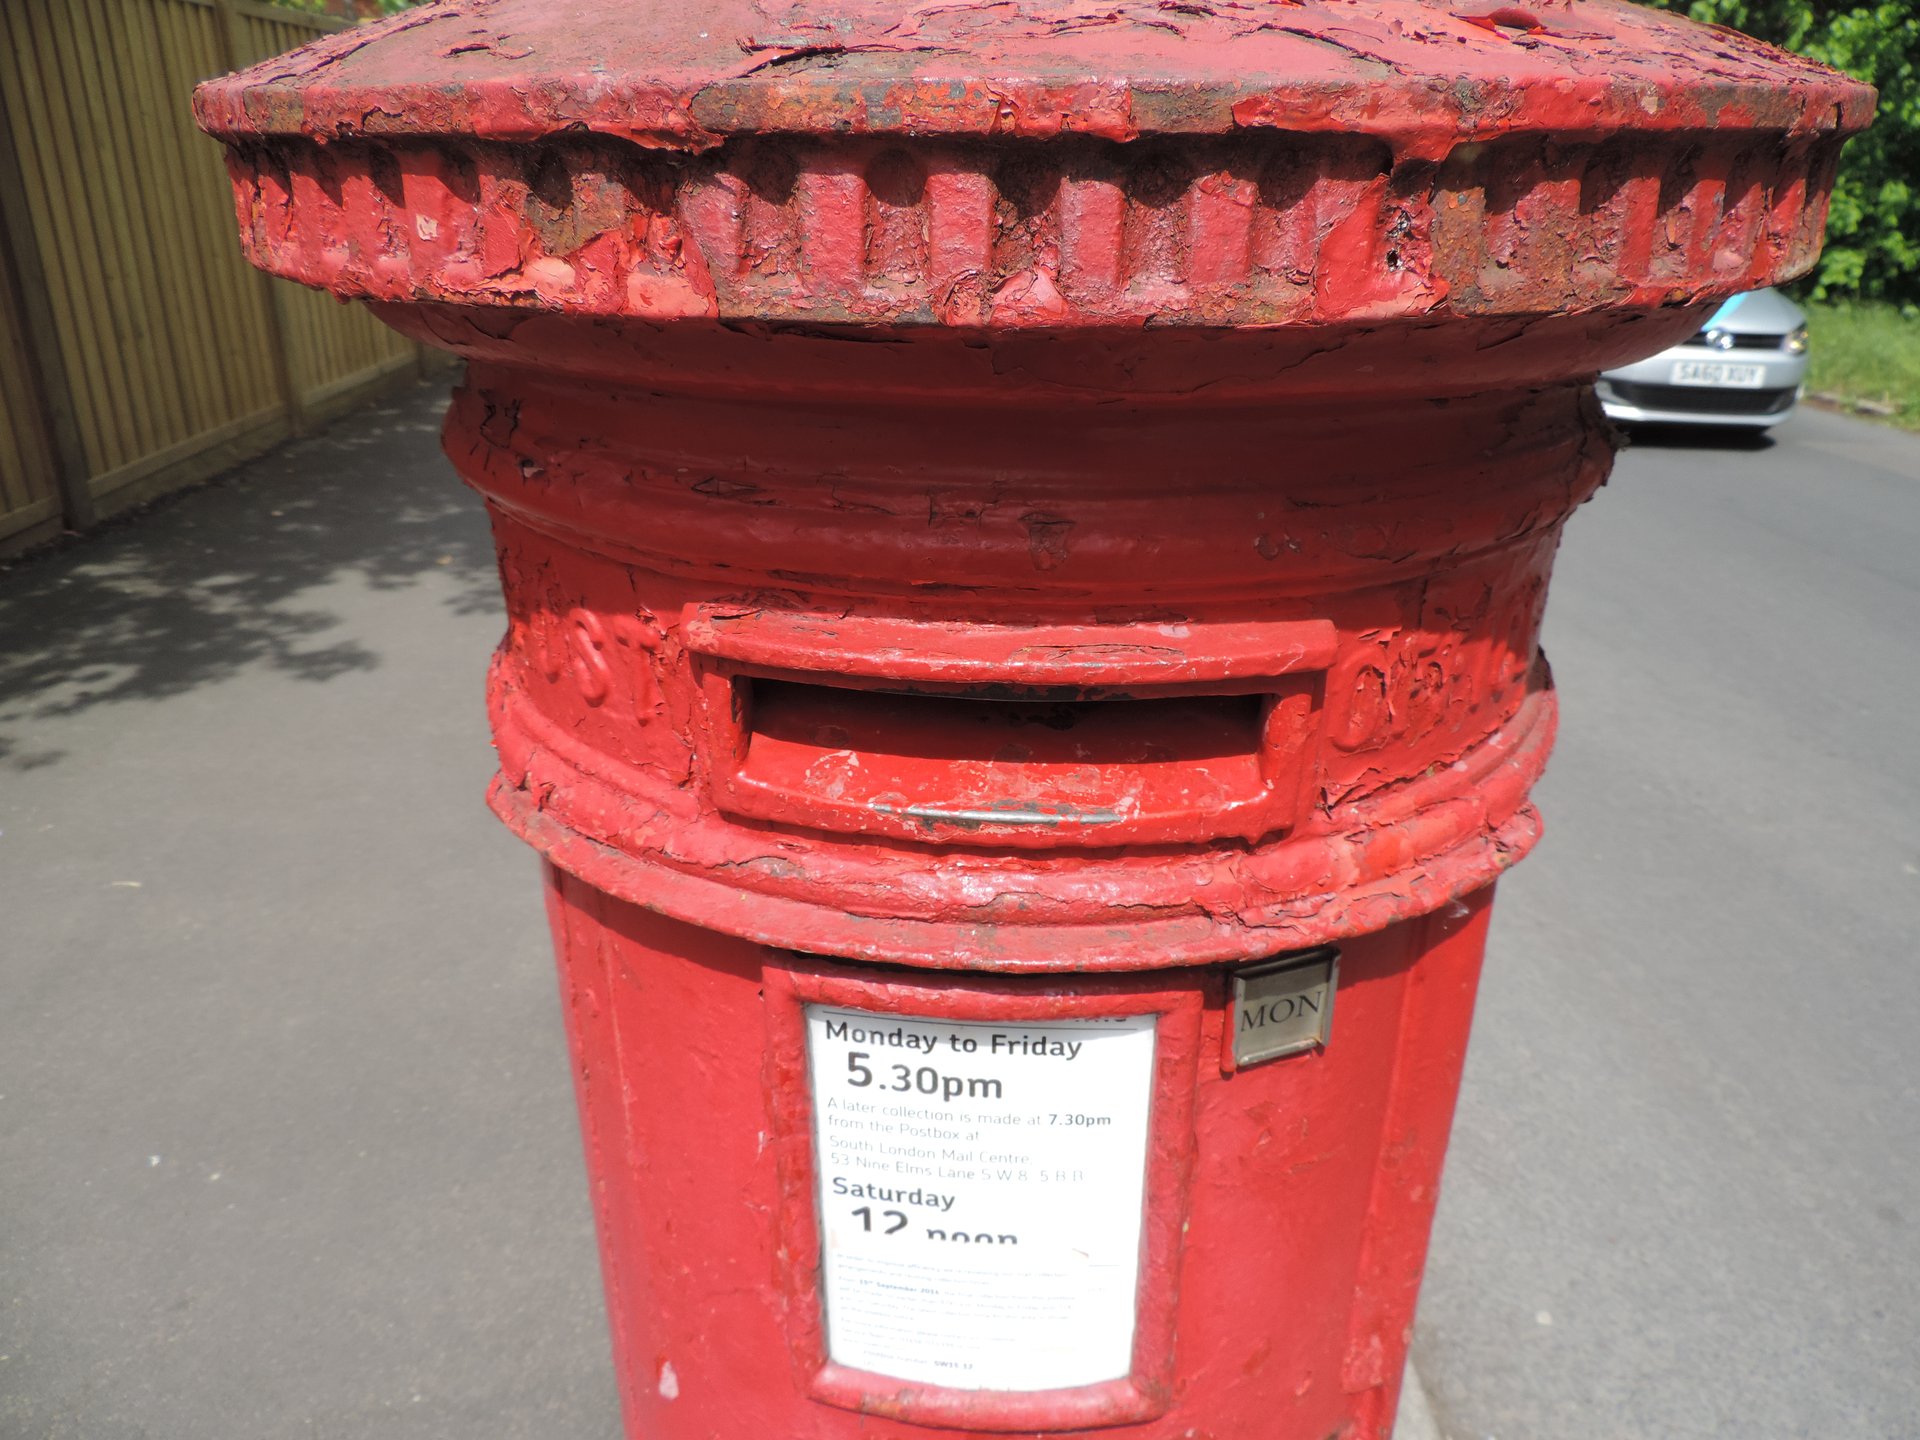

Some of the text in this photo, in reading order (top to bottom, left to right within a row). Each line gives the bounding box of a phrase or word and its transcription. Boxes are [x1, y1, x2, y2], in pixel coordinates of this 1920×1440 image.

[1241, 991, 1323, 1032] MON
[826, 1020, 1082, 1061] Monday to Friday
[847, 1051, 1003, 1102] 5.30pm
[827, 1097, 1111, 1128] A later collection is made at 7.30pm
[828, 1114, 980, 1141] from the Postbox at
[829, 1135, 874, 1152] South
[880, 1142, 936, 1160] London
[942, 1148, 973, 1162] Mail
[831, 1152, 850, 1166] 53
[856, 1156, 890, 1171] Nine
[896, 1160, 932, 1176] Elms
[938, 1166, 975, 1180] Lane
[832, 1177, 956, 1212] Saturday
[851, 1206, 1018, 1245] 12 noon
